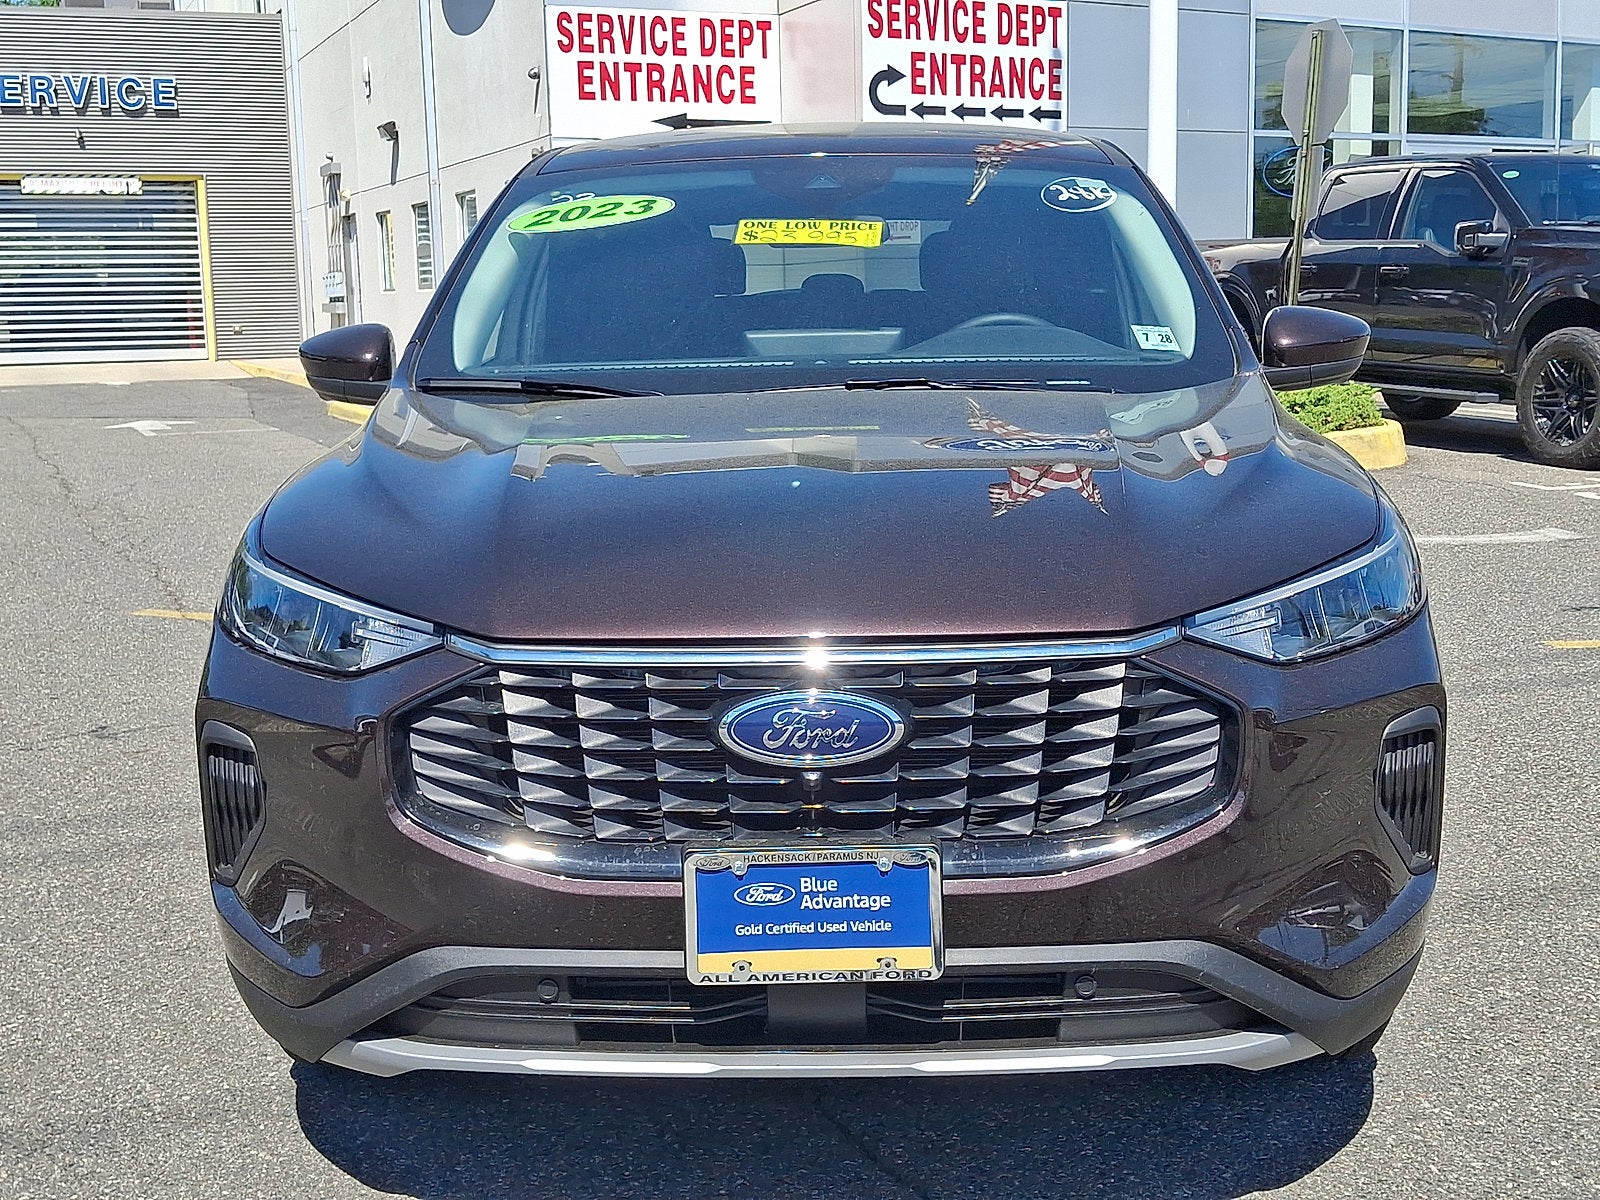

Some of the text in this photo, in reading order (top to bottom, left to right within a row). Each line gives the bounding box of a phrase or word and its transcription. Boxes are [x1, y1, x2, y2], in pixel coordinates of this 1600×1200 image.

[868, 0, 1062, 48] SERVICE DEPT
[557, 12, 772, 59] SERVICE DEPT
[577, 61, 756, 104] ENTRANCE
[911, 51, 1062, 100] ENTRANCE
[523, 199, 658, 229] 2023
[743, 221, 878, 231] ONE LOW PRICE
[1142, 332, 1173, 344] 7 28
[762, 707, 860, 749] Ford
[700, 857, 724, 867] Ford
[866, 851, 879, 860] NJ
[800, 876, 838, 893] Blue
[745, 886, 785, 902] Ford
[800, 893, 892, 911] Advantage
[735, 920, 892, 936] Gold Certified Used Vehicle
[699, 969, 933, 983] ALL AMERICAN FORD
